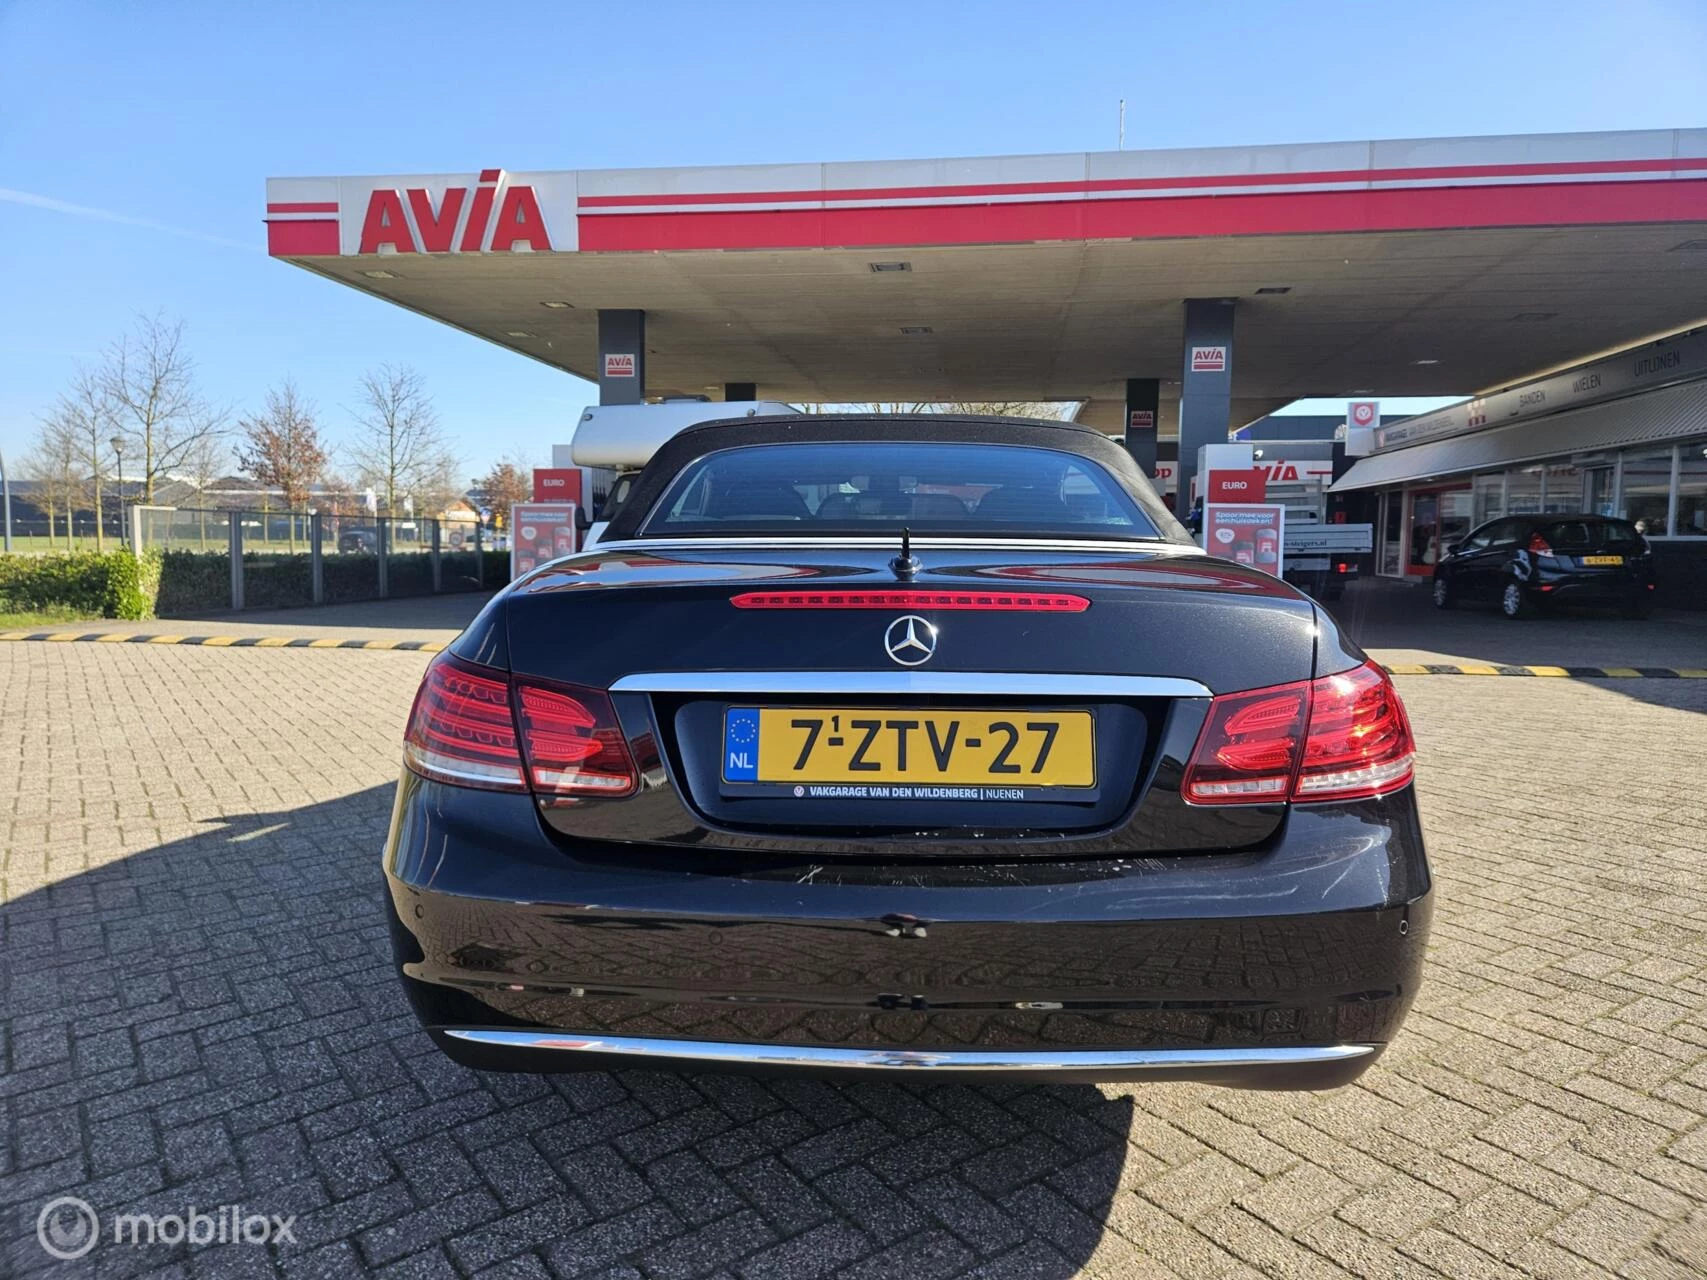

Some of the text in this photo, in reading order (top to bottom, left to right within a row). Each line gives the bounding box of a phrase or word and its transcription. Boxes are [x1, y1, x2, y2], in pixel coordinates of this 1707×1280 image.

[359, 168, 553, 254] AVIA
[607, 355, 633, 366] AVIA
[1195, 348, 1223, 360] AVIA
[1573, 374, 1601, 393] WIELEN
[1253, 459, 1299, 481] VIA
[1222, 480, 1248, 490] EURO
[729, 753, 754, 768] NL
[809, 786, 1024, 799] VAKGARAGE VAN DEN WILDENBERG NUENEN
